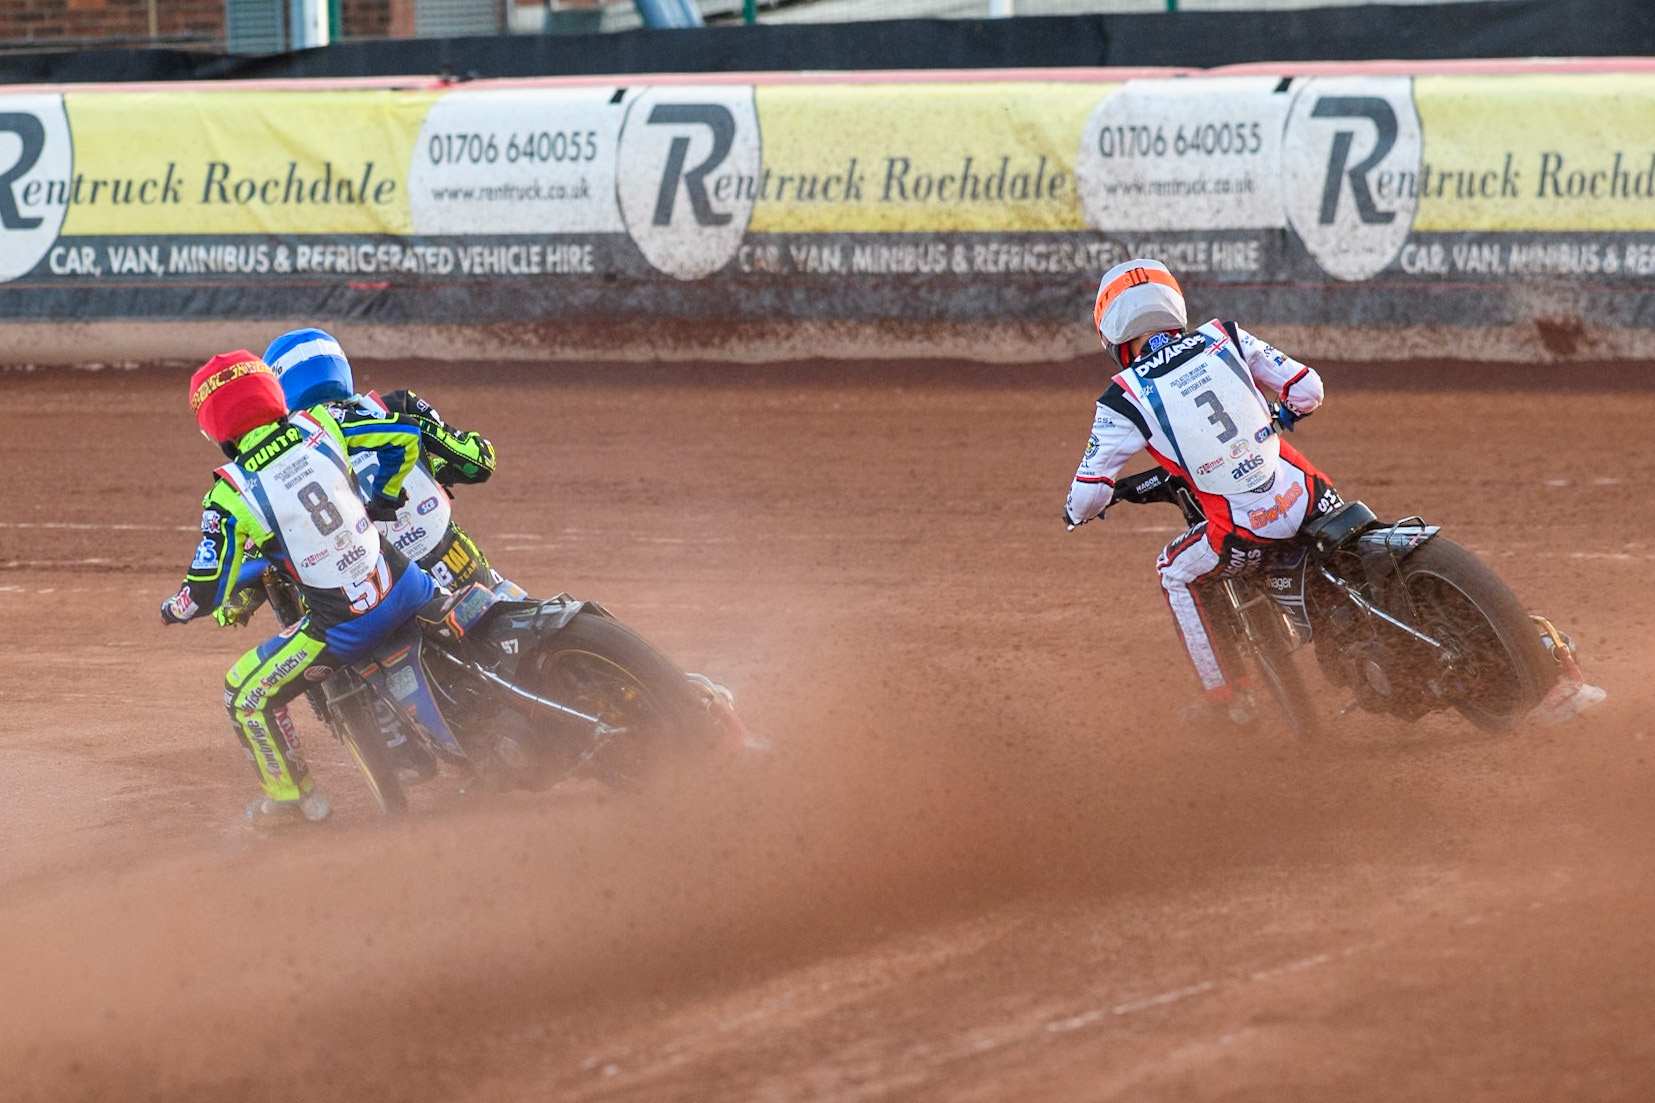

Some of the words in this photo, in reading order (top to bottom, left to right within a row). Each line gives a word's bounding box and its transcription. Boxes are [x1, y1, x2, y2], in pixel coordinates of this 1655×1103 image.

[428, 132, 499, 165] 01706
[506, 130, 597, 163] 640055
[1099, 124, 1168, 158] 01706
[1174, 122, 1262, 156] 640055
[646, 103, 864, 227] Rentruck
[882, 153, 1067, 203] Rochdale
[1309, 96, 1521, 225] Rentruck
[201, 161, 397, 206] Rochdale
[431, 178, 591, 202] www.rentruck.co.uk
[1103, 174, 1254, 197] www.rentruck.co.uk
[49, 245, 101, 277] CAR,
[108, 245, 164, 277] VAN,
[169, 245, 270, 273] MINIBUS
[273, 244, 292, 272] &
[296, 243, 453, 274] REFRIGERATED
[458, 244, 541, 274] VEHICLE
[545, 243, 595, 273] HIRE
[852, 243, 946, 274] MINIBUS
[952, 244, 969, 274] &
[1212, 241, 1259, 271] HIRE
[1193, 390, 1238, 444] 3
[244, 427, 302, 472] OUNTA
[1231, 453, 1264, 480] attis
[297, 481, 344, 536] 8
[394, 526, 427, 549] attis
[336, 545, 367, 571] attis
[460, 560, 478, 583] TEAM
